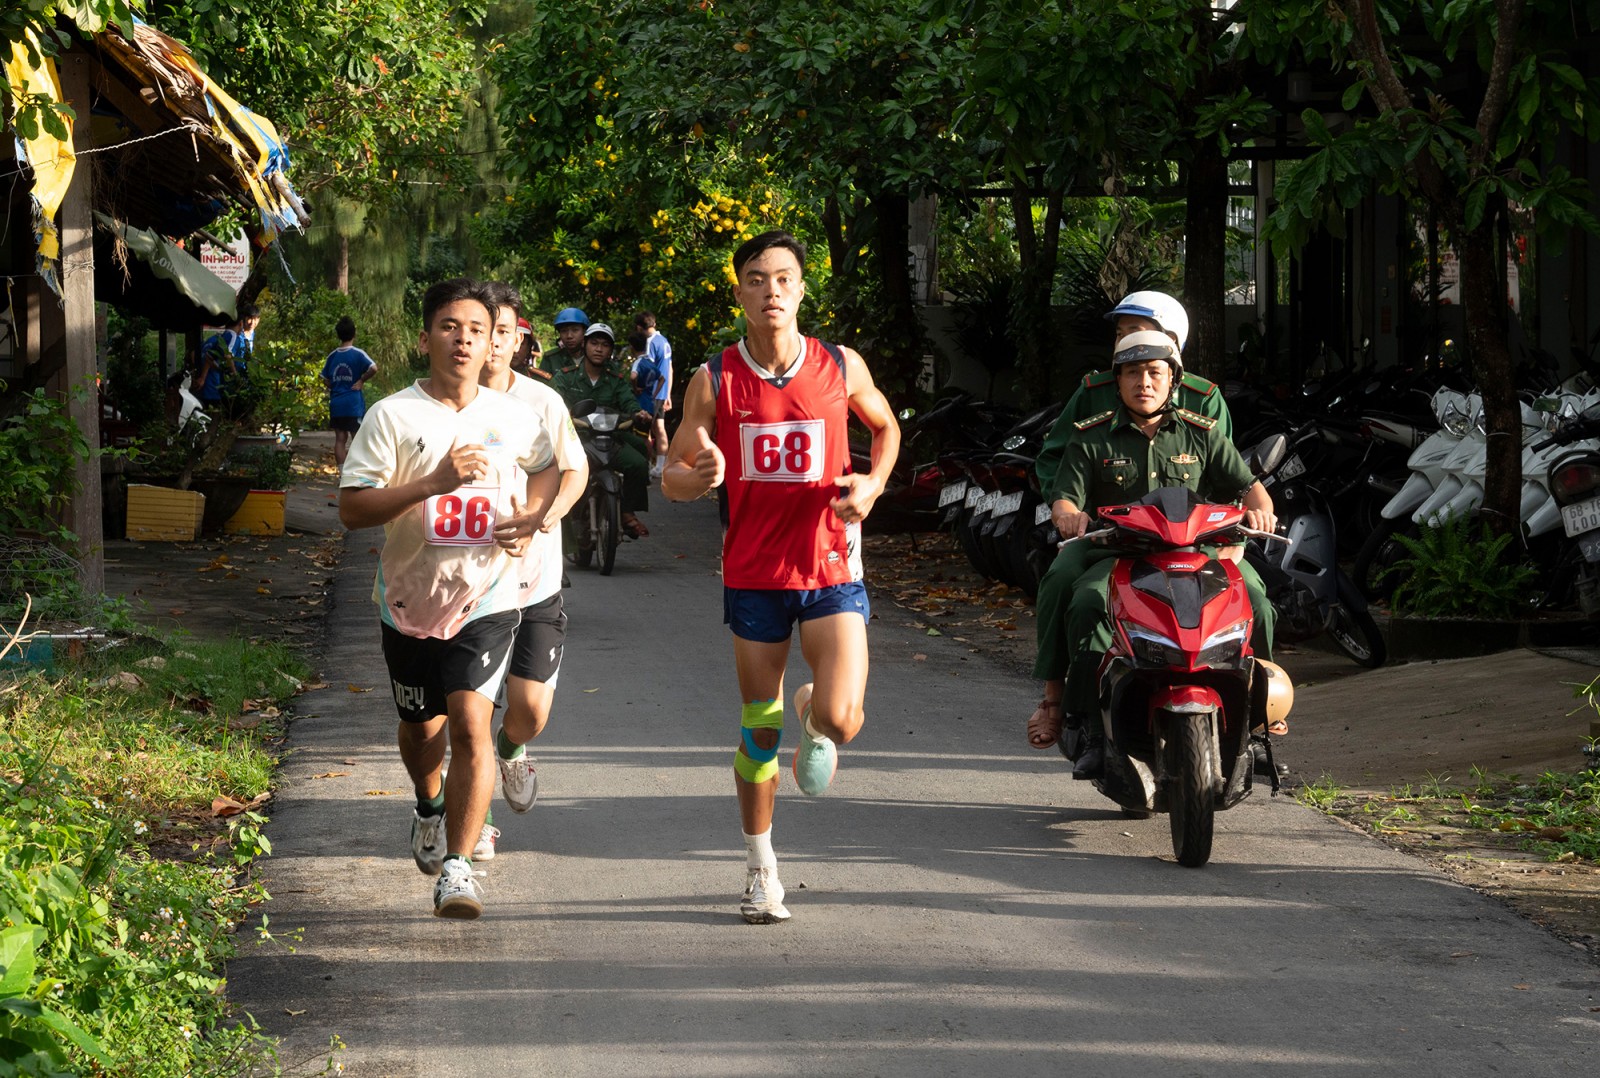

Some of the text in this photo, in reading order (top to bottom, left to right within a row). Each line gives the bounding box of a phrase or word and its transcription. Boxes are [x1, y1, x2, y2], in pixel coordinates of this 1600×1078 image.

[200, 252, 245, 264] INH PHÚ
[753, 431, 812, 474] 68
[434, 494, 490, 539] 86
[1572, 512, 1600, 532] 400
